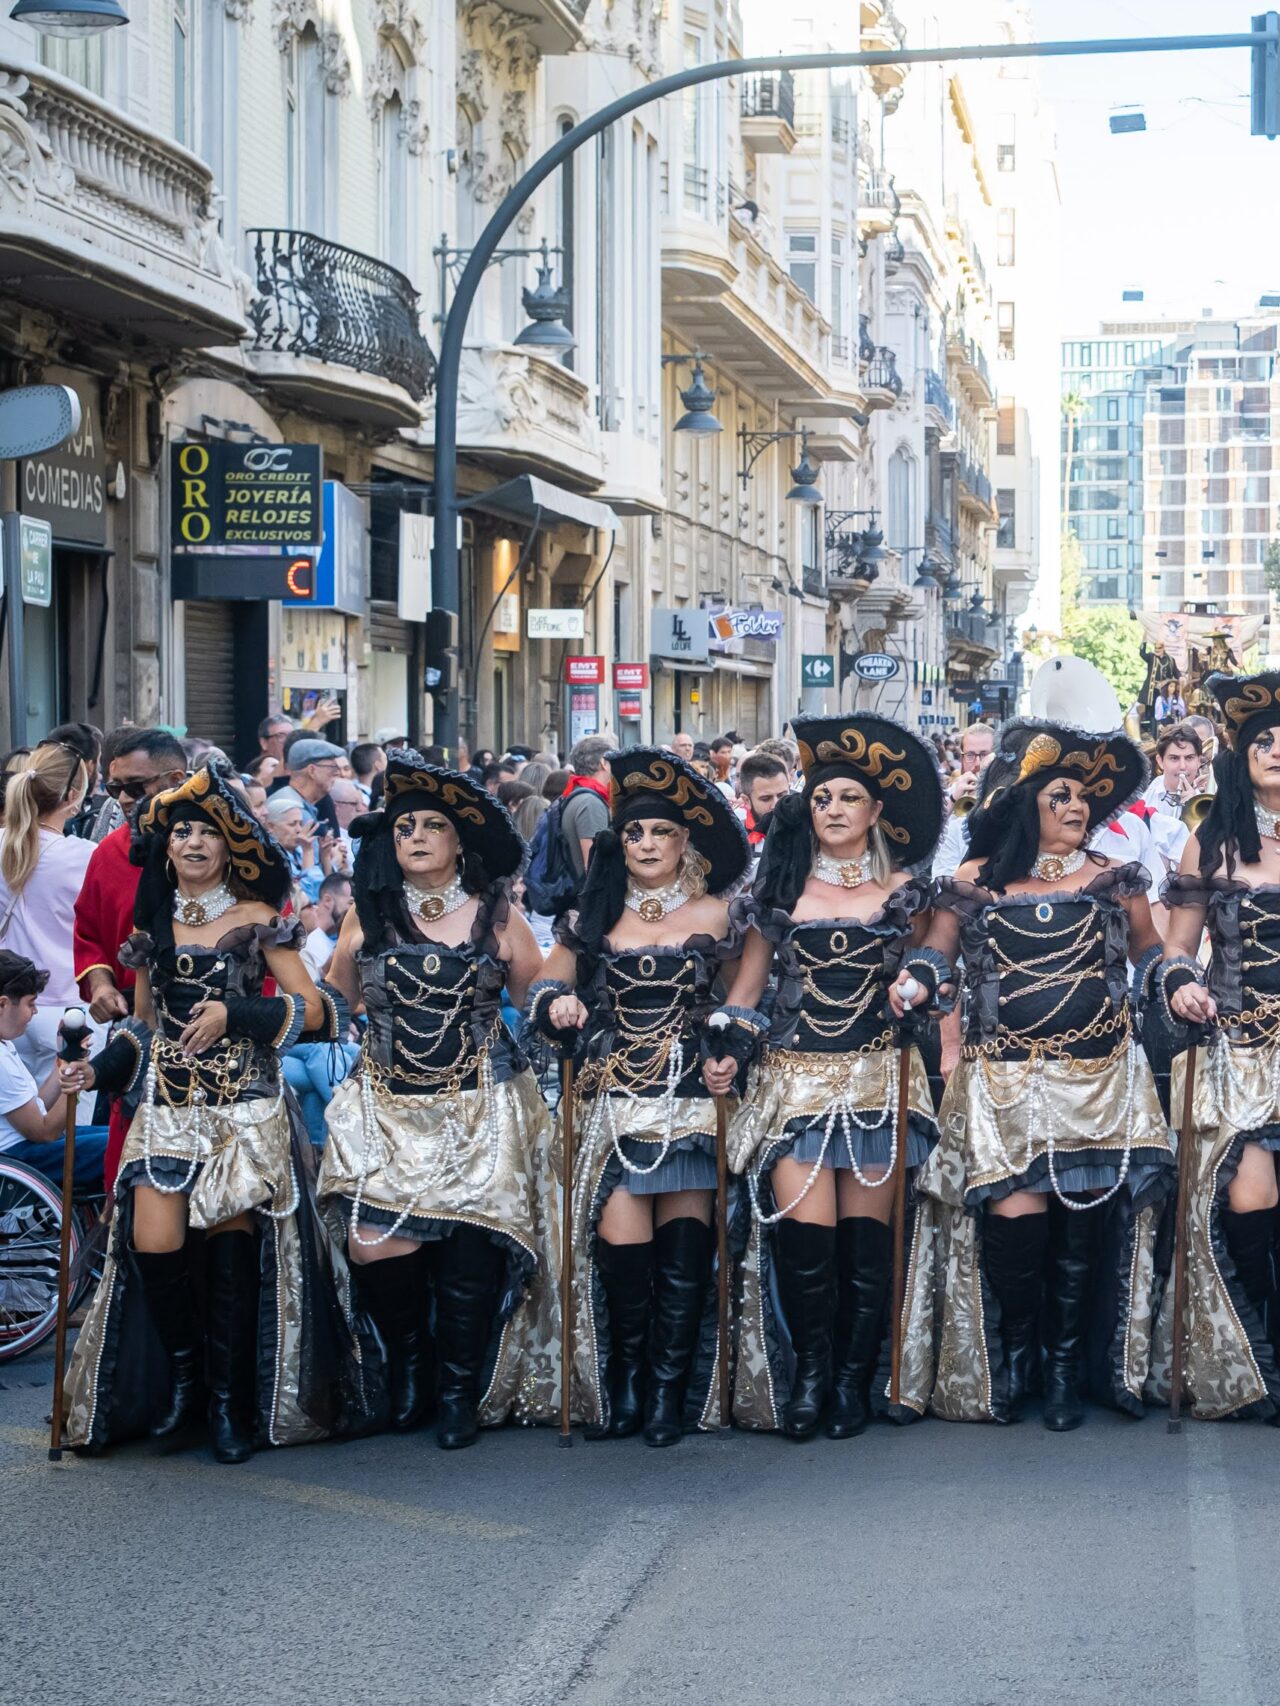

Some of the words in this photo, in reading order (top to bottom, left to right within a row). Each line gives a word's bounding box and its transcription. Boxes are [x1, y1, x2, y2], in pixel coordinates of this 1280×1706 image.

[225, 472, 255, 481] ORO
[258, 472, 311, 481] CREDIT
[25, 460, 103, 514] COMEDIAS
[179, 445, 211, 542] ORO
[225, 486, 312, 504] JOYERÍA
[225, 510, 312, 524] RELOJES
[225, 530, 312, 541] EXCLUSIVOS
[732, 612, 777, 635] Folder
[570, 662, 598, 670] EMT
[617, 668, 642, 676] EMT
[863, 667, 888, 676] LANE
